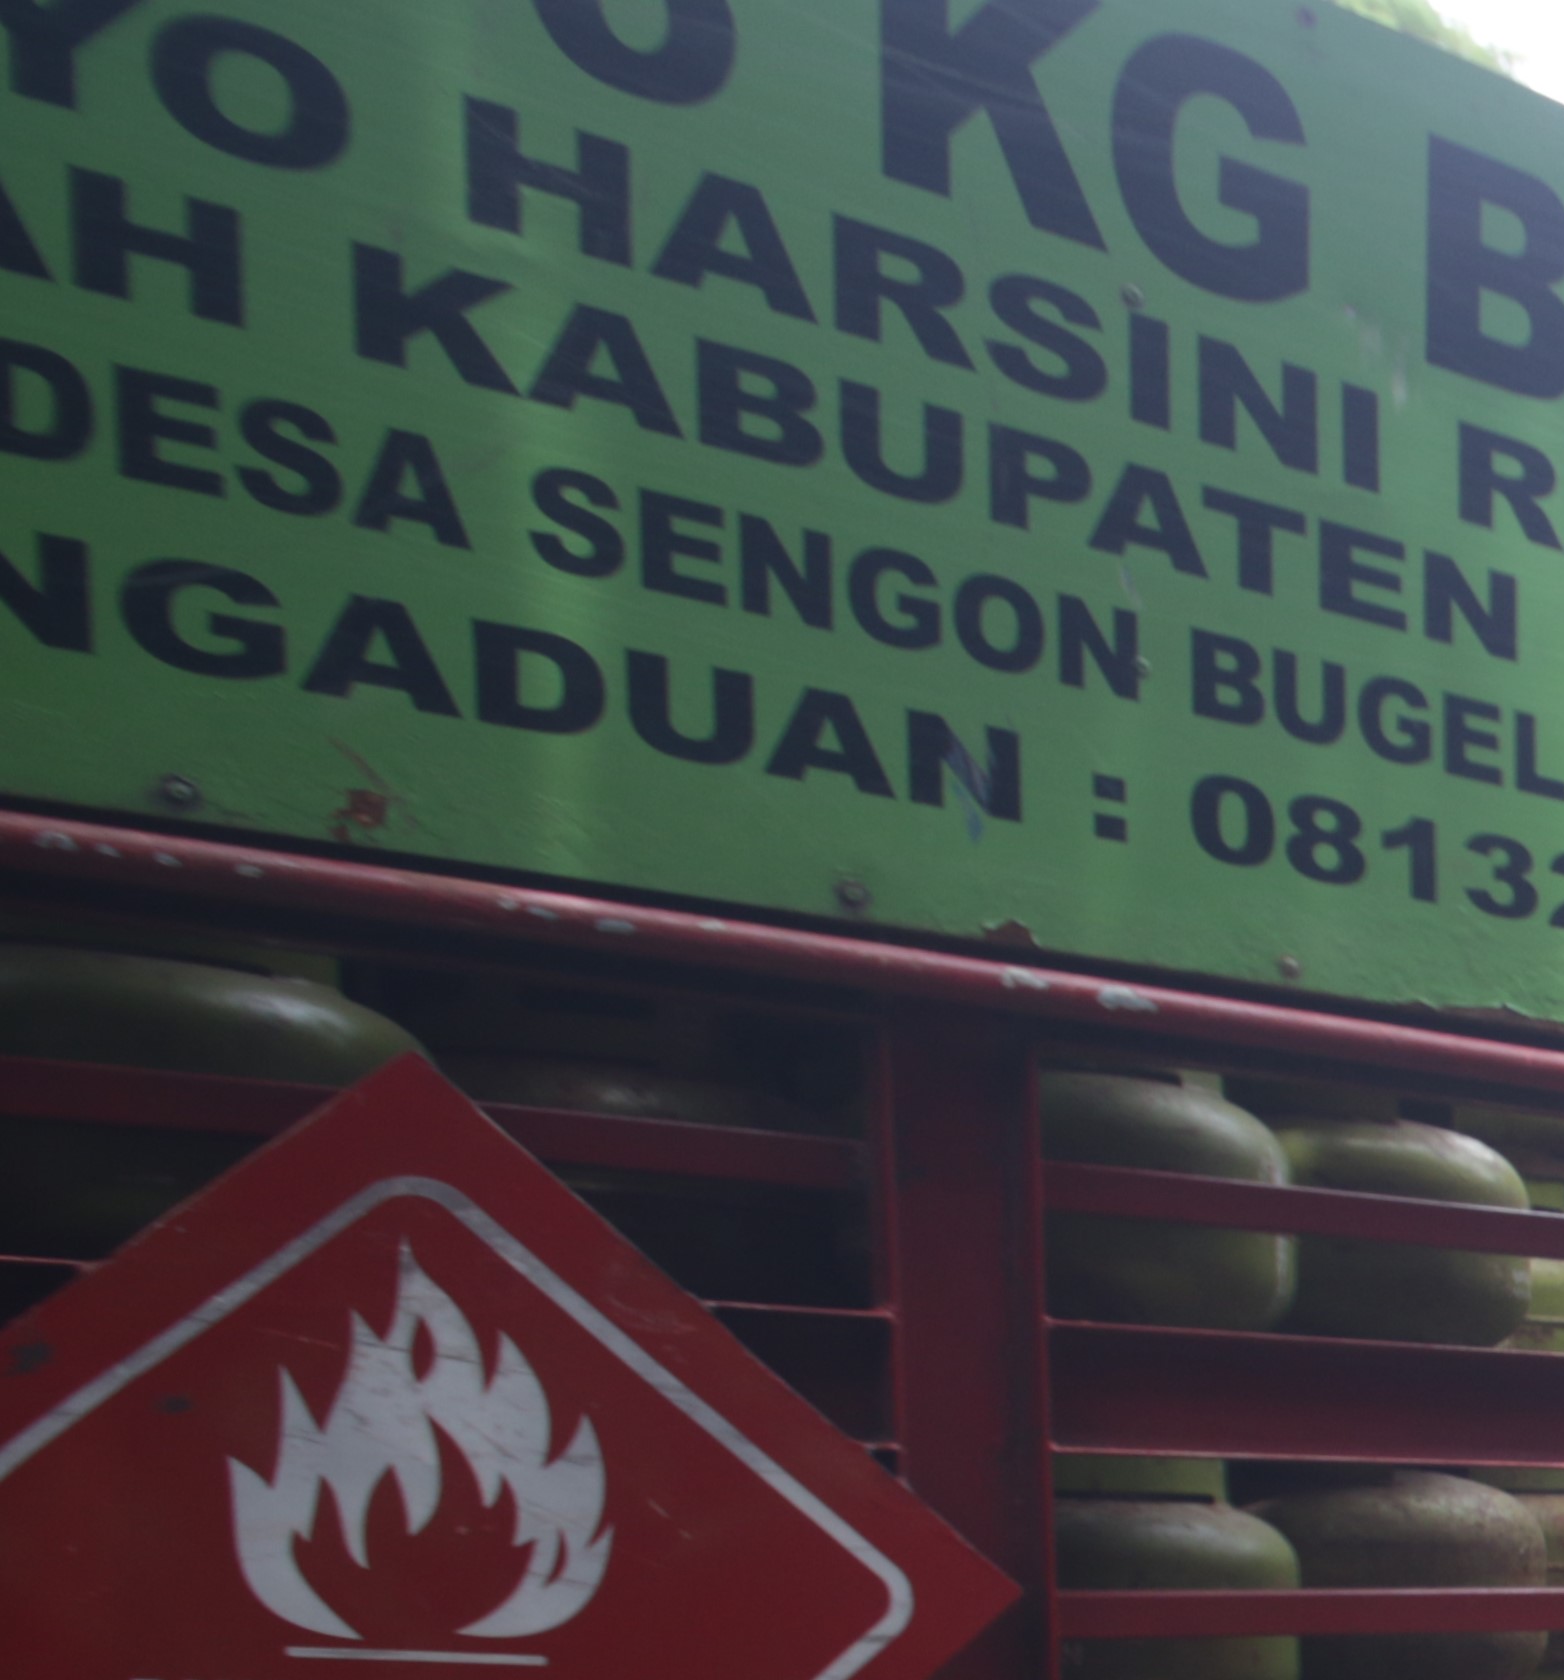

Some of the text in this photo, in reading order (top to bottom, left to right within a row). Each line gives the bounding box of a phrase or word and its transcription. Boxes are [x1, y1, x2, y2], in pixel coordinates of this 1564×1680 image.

[464, 94, 1383, 494] HARSINI
[879, 0, 1311, 303] KG
[0, 337, 472, 550] DESA
[531, 468, 1146, 701] SENGON
[352, 242, 1519, 662] KABUPATEN
